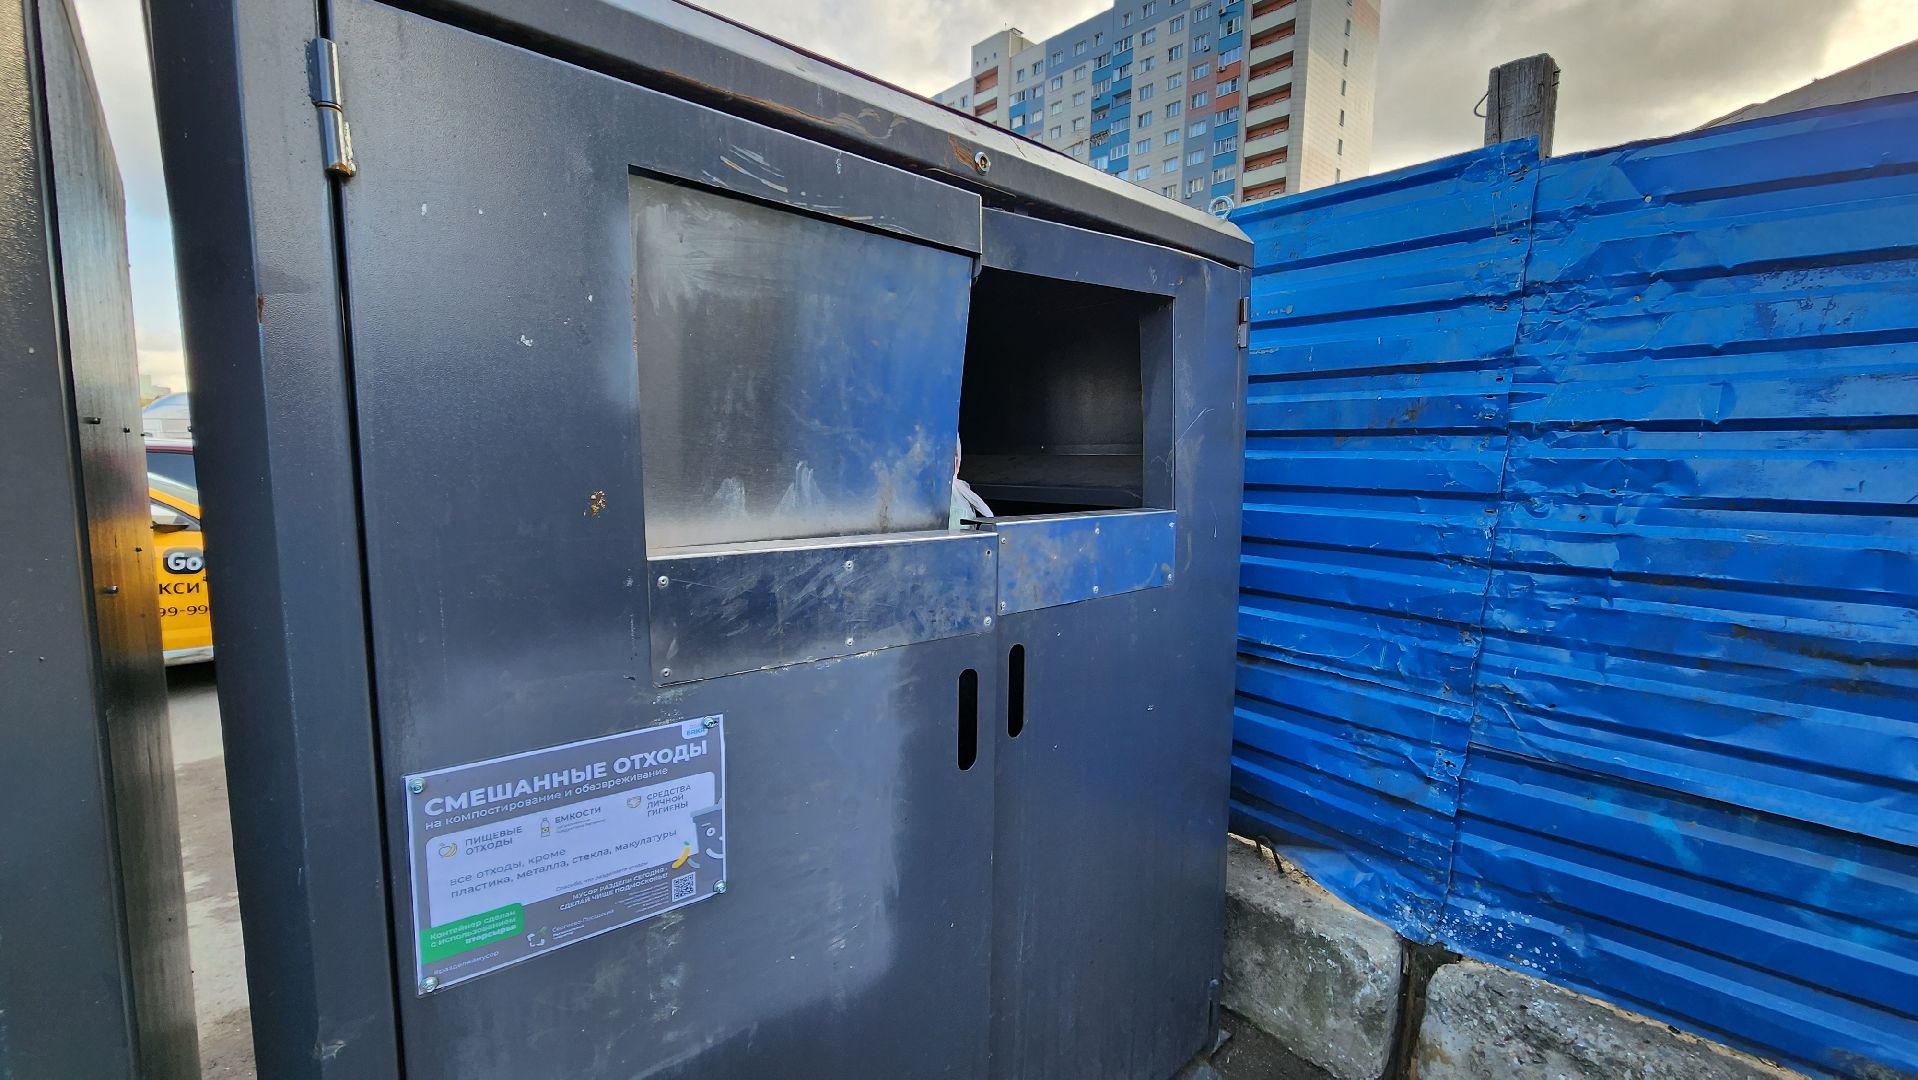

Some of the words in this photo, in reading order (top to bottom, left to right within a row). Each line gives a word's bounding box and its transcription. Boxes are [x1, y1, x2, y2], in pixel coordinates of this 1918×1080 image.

[424, 761, 607, 816] СМЕШАННЫЕ
[613, 740, 707, 774] ОТХОДЫ
[646, 784, 692, 801] СРЕДСТВА
[425, 820, 442, 831] на
[445, 791, 562, 826] компостирование
[564, 789, 572, 797] и
[574, 767, 668, 795] обезвреживание
[646, 794, 684, 810] ЛИЧНОЙ
[647, 801, 689, 818] ГИГИЕНЫ
[555, 806, 601, 824] ЕМКОСТИ
[465, 826, 523, 846] ПИЩЕВЫЕ
[465, 838, 513, 856] ОТХОДЫ
[451, 876, 514, 898] пластика,
[516, 860, 569, 880] металла,
[572, 848, 612, 864] стекла,
[615, 830, 677, 852] макулатуры
[476, 860, 525, 879] отходы,
[528, 849, 566, 866] кроме
[559, 895, 591, 911] СДЕЛАЙ
[592, 889, 614, 901] ЧИЩЕ
[614, 872, 668, 894] ПОДМОСКОВЬЕ!
[572, 888, 599, 900] МУСОР
[599, 878, 633, 894] РАЗДЕЛИ
[633, 867, 665, 881] СЕГОДНЯ
[430, 920, 482, 940] Контейнер
[483, 910, 516, 924] сделан
[438, 918, 516, 946] использованием
